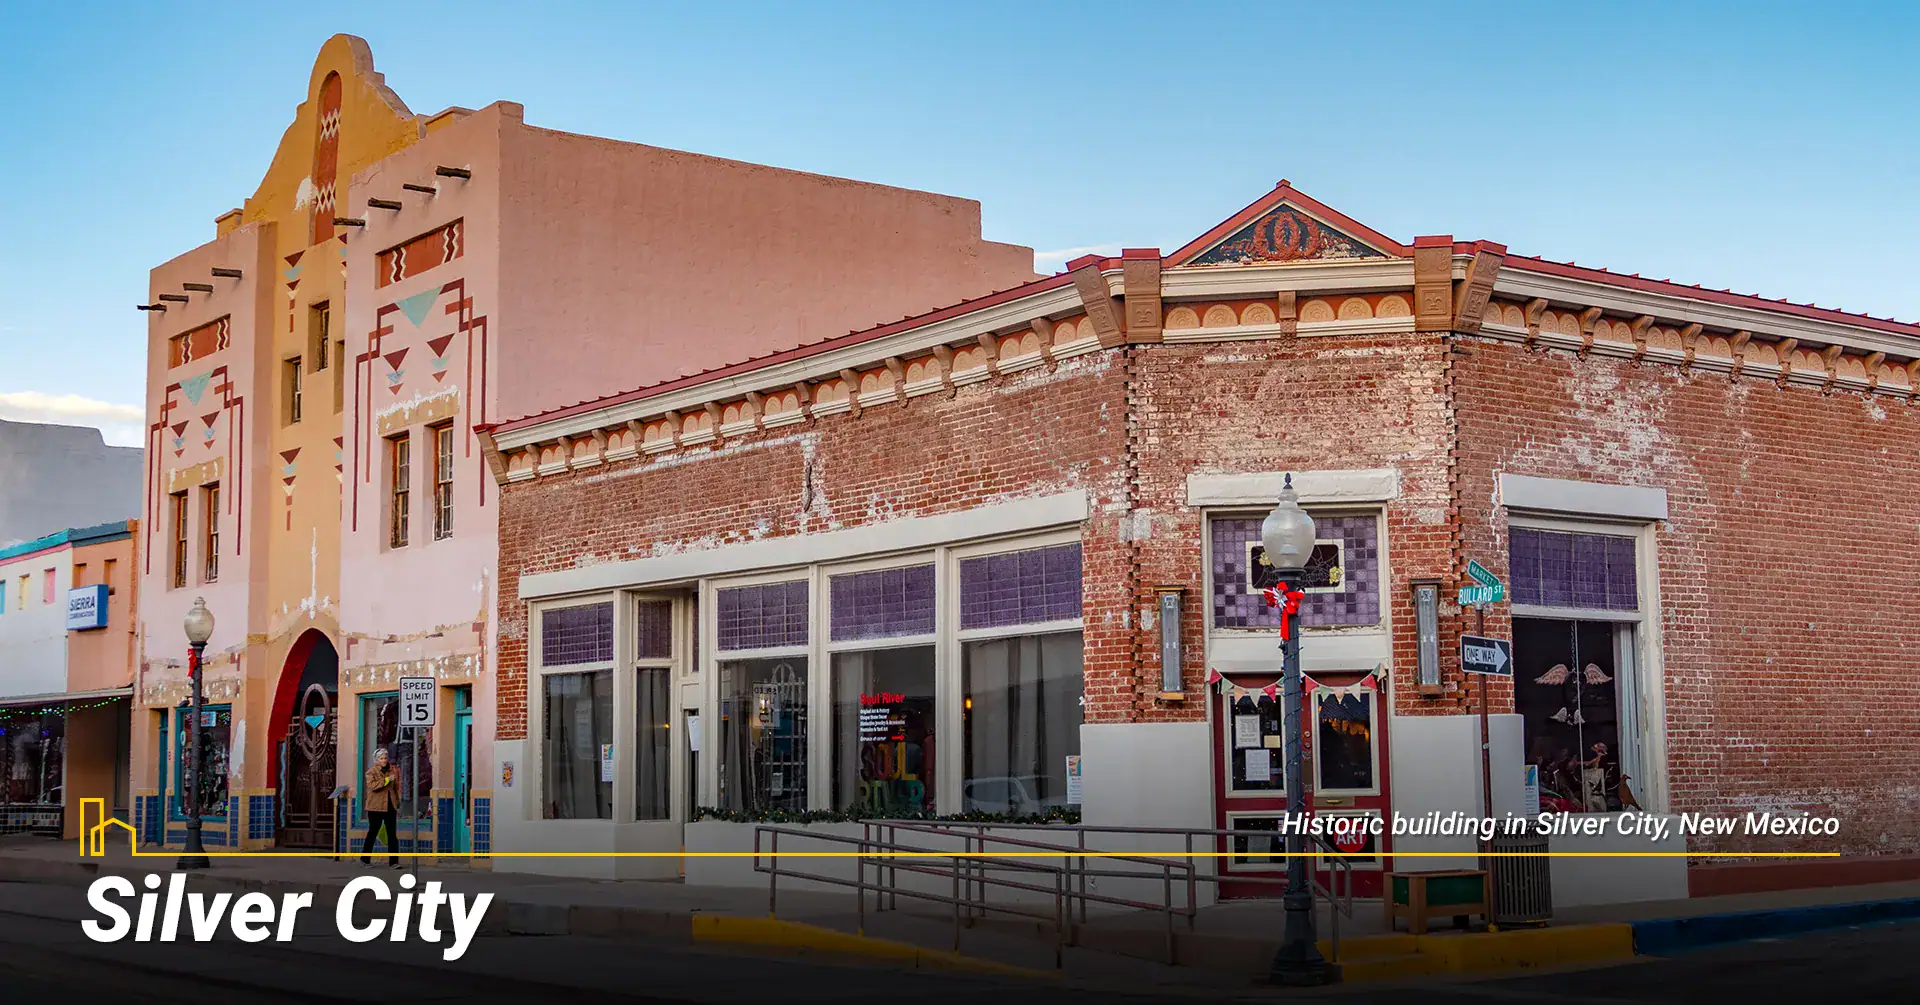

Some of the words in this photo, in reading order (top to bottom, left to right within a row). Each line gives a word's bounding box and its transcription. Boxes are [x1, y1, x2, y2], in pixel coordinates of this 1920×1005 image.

[1471, 564, 1494, 586] MARKET
[70, 595, 95, 611] SIERRA
[1458, 586, 1493, 605] BULLARD
[1494, 585, 1502, 594] ST
[1466, 647, 1479, 661] ONE
[1482, 650, 1496, 662] WAY
[402, 682, 433, 690] SPEED
[860, 693, 880, 705] Soul
[882, 691, 906, 704] River
[406, 703, 429, 721] 15
[1336, 829, 1364, 845] ART
